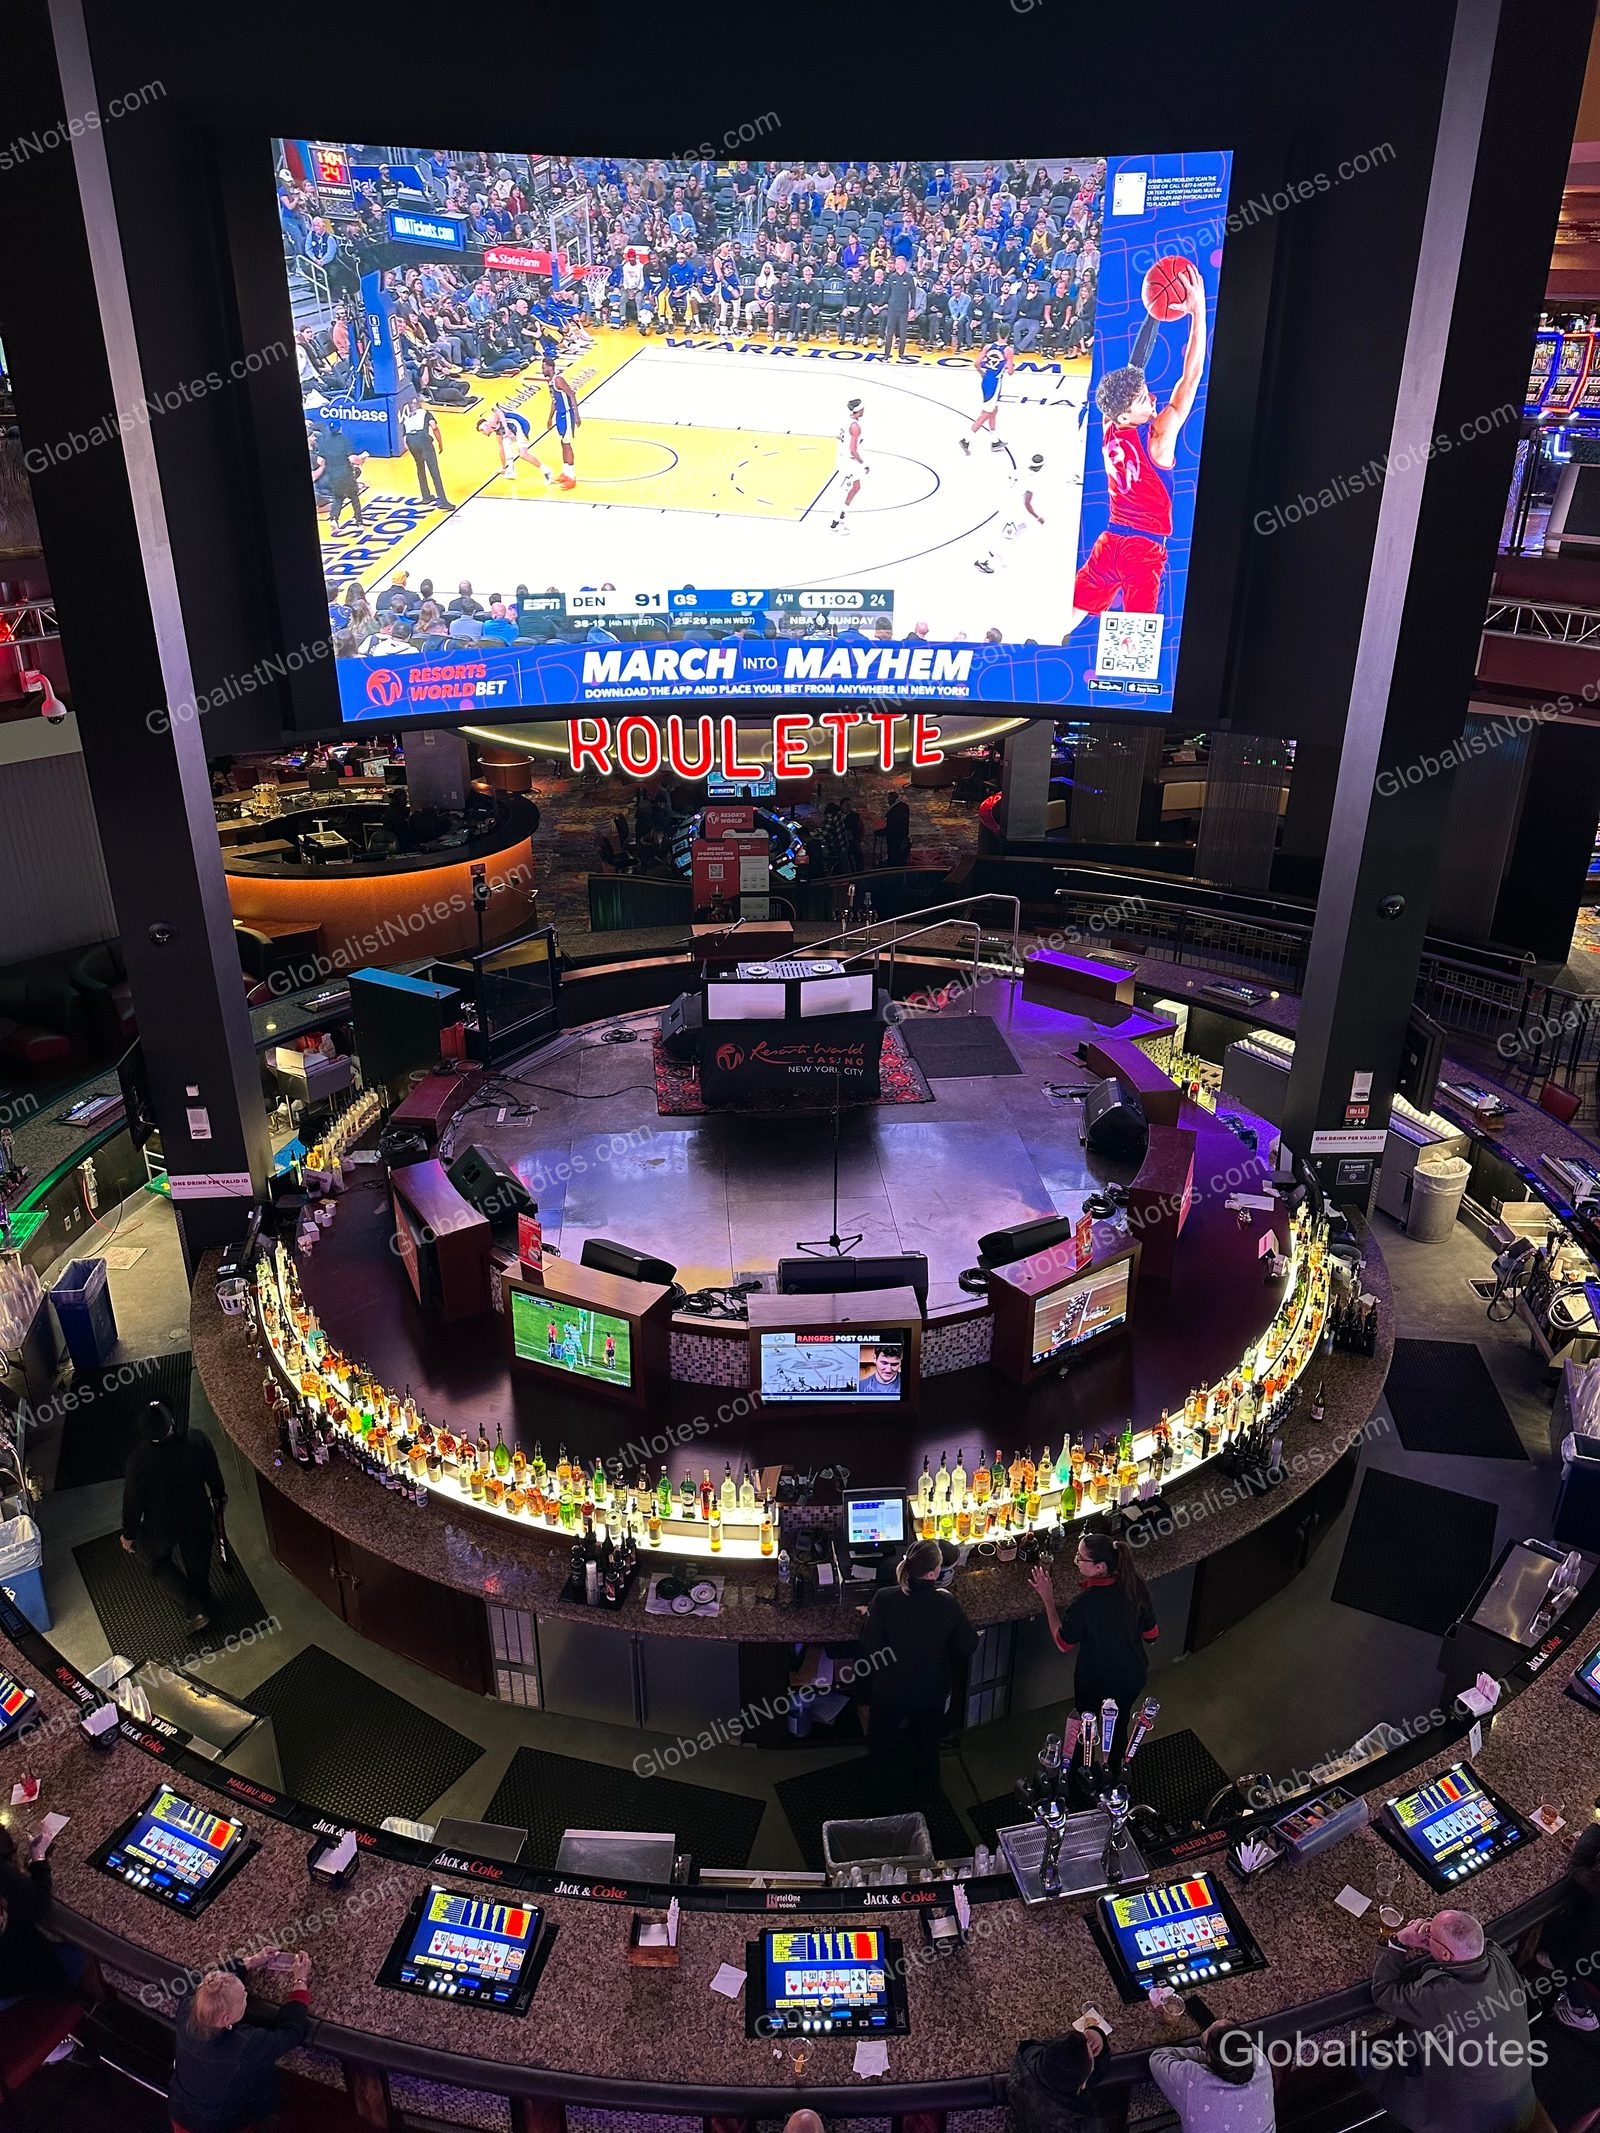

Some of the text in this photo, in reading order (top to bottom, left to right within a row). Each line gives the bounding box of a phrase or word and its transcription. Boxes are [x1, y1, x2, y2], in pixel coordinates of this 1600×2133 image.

[665, 338, 1062, 374] WARRIORS.CM
[320, 404, 388, 423] coinbase
[573, 597, 606, 607] DEN
[634, 593, 662, 606] 91
[674, 594, 698, 605] GS
[731, 591, 764, 605] 87
[775, 594, 793, 606] 4TH
[806, 595, 858, 606] 11:04
[869, 594, 886, 606] 24
[573, 619, 605, 627] 38-19
[631, 619, 655, 628] WEST)
[730, 617, 755, 626] WEST)
[790, 616, 875, 626] NBA SUNDAY
[409, 664, 487, 683] RESORTS
[582, 647, 974, 683] MARCH INTO MAYHEM
[411, 680, 507, 702] WORLDBET
[585, 684, 970, 698] DOWNLOAD THE APP AND PLACE YOUR BET FROM ANYWHERE IN NEW YORK!
[567, 713, 945, 781] ROULETTE
[844, 1068, 864, 1076] CITY
[1525, 1656, 1545, 1672] JACK
[1541, 1636, 1563, 1654] Coke
[56, 1665, 76, 1687] Coke
[160, 1721, 178, 1737] JACK
[139, 1734, 166, 1755] Coke
[227, 1777, 258, 1798] MALIBU
[257, 1792, 277, 1805] RED
[312, 1818, 336, 1835] JACK
[1171, 1829, 1227, 1856] MALIBU RED
[434, 1852, 503, 1879] JACK & Coke
[554, 1881, 628, 1900] JACK & Coke
[863, 1891, 937, 1906] JACK & Coke
